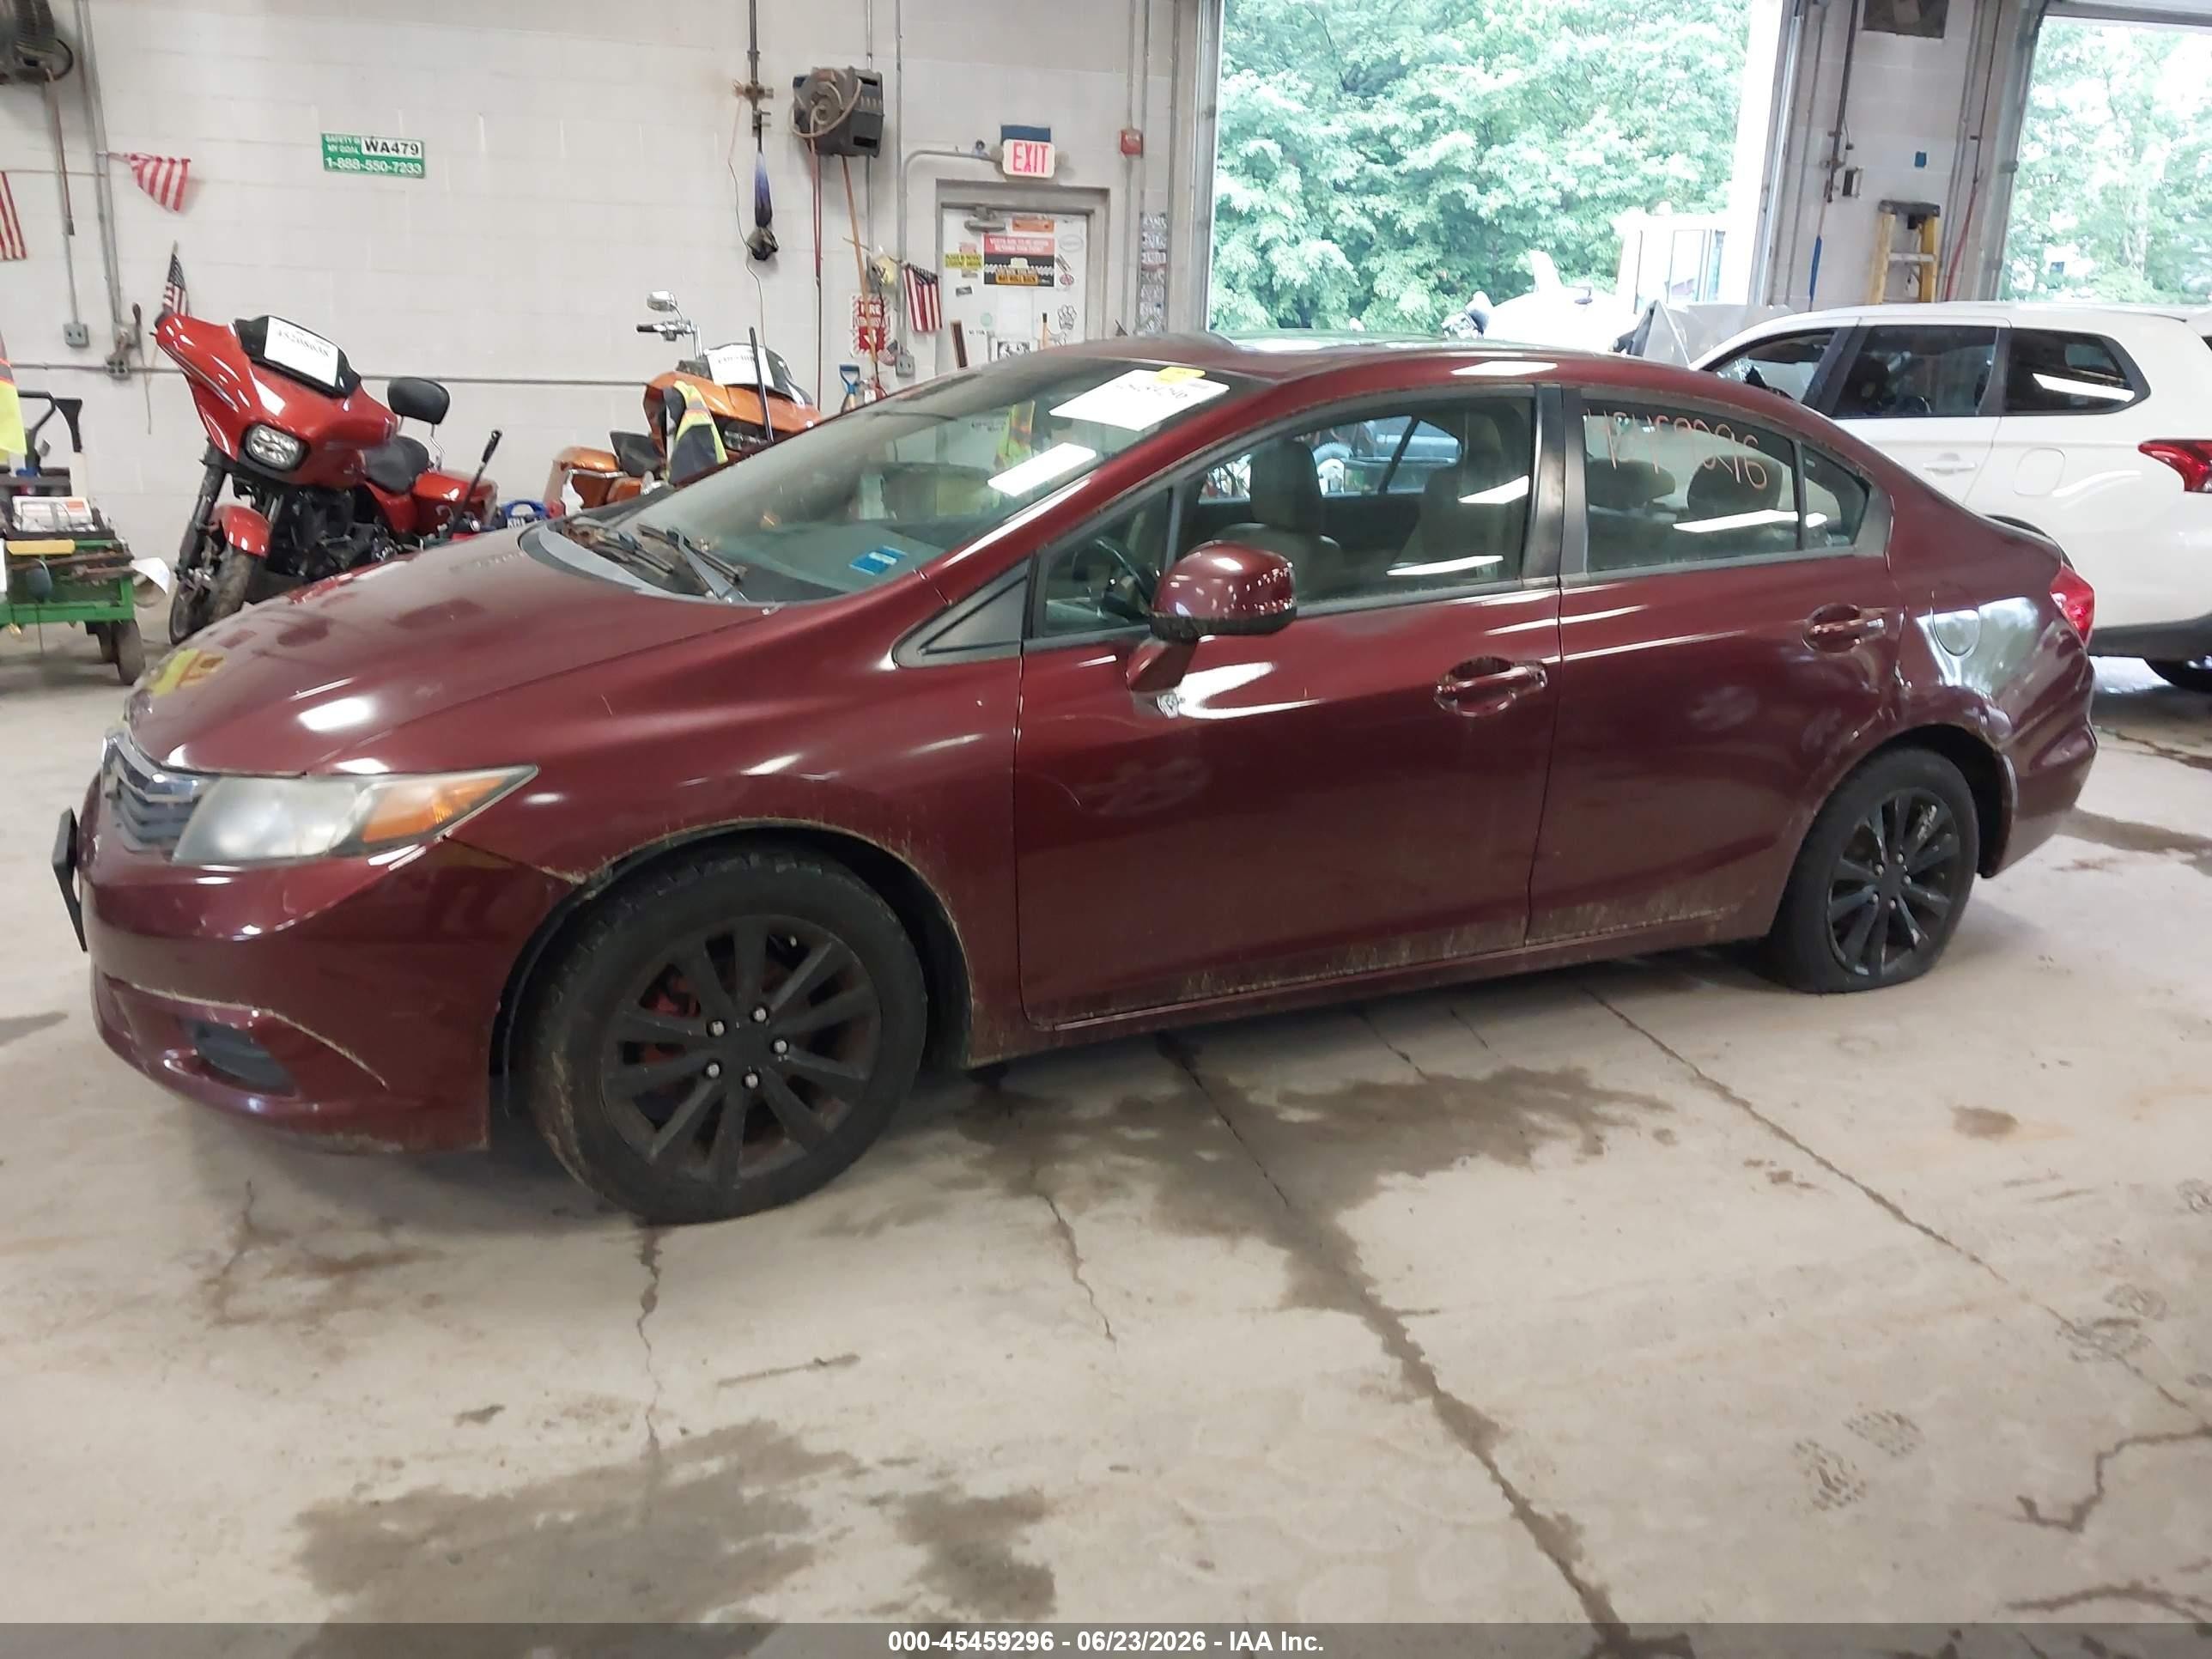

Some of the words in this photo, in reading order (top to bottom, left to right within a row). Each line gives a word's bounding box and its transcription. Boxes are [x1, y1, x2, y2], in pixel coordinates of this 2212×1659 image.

[364, 139, 419, 155] WA479
[1012, 142, 1049, 173] EXIT
[860, 302, 880, 315] FRE
